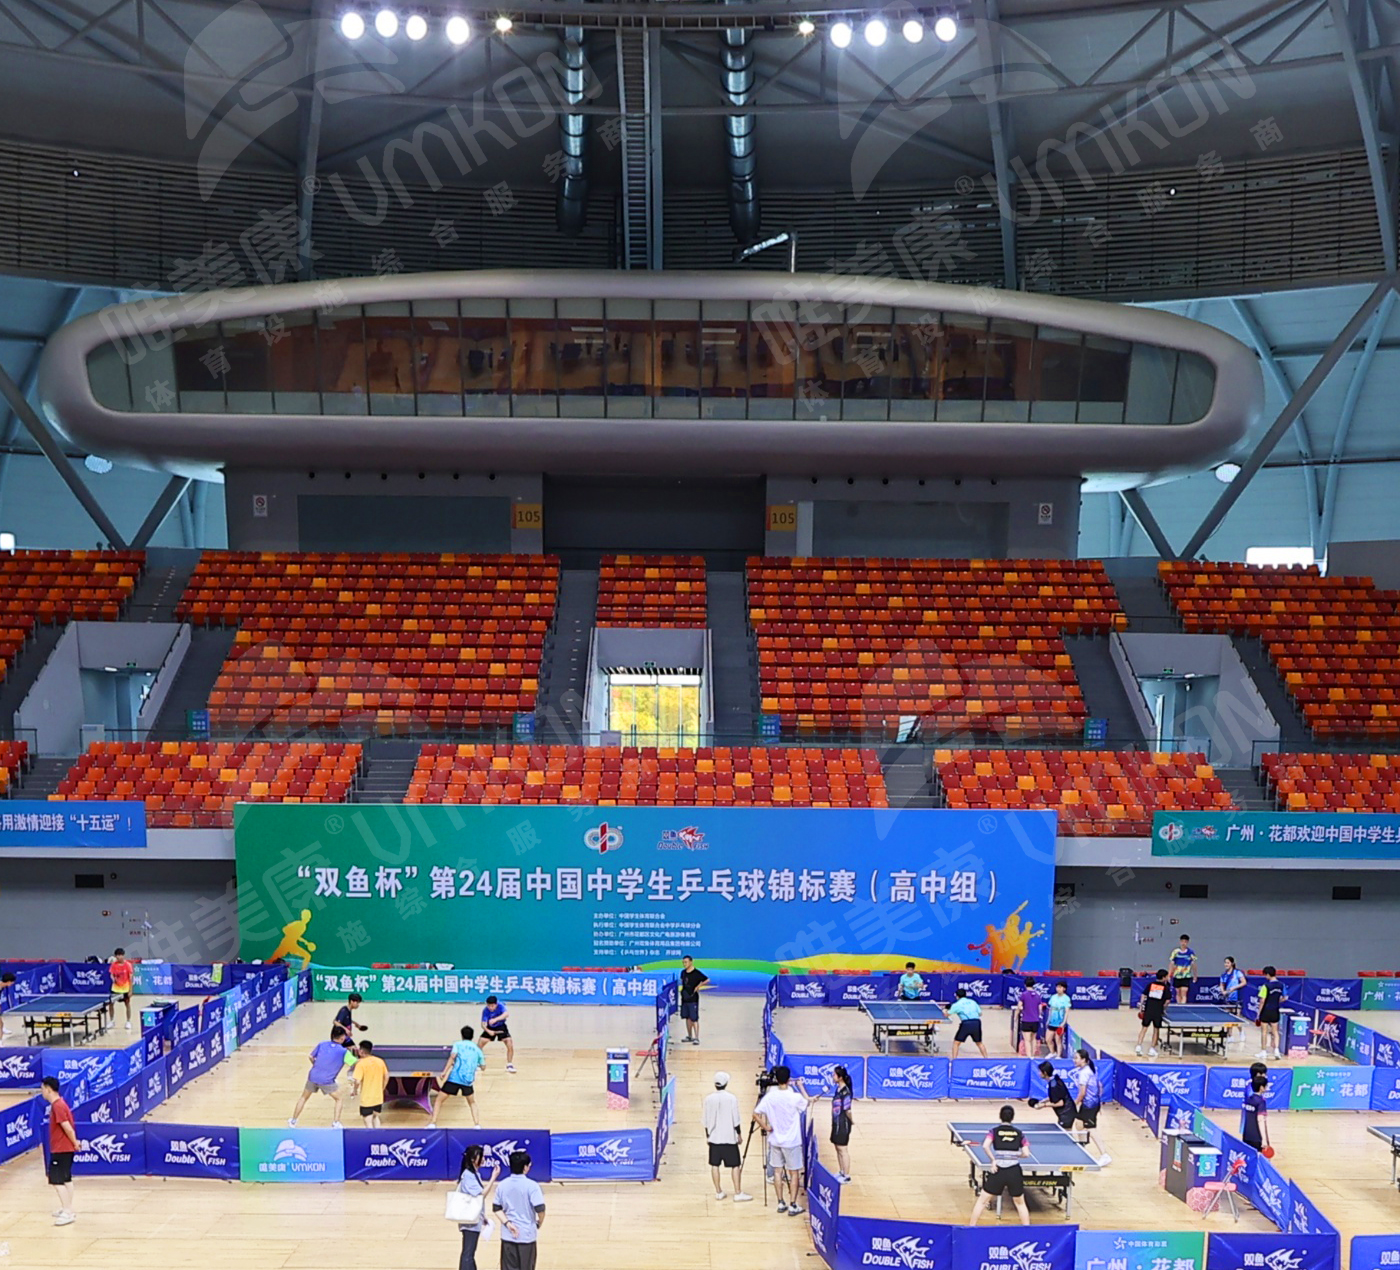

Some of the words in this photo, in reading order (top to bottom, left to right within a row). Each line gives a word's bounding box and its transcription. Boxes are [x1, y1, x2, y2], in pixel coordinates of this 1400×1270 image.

[517, 510, 541, 523] 105
[771, 512, 795, 525] 105
[18, 1070, 35, 1078] FISH
[918, 1080, 934, 1088] FISH
[1296, 1083, 1369, 1098] 广州·花都
[409, 1157, 428, 1167] FISH
[1204, 1162, 1211, 1171] 3
[911, 1258, 934, 1270] FISH
